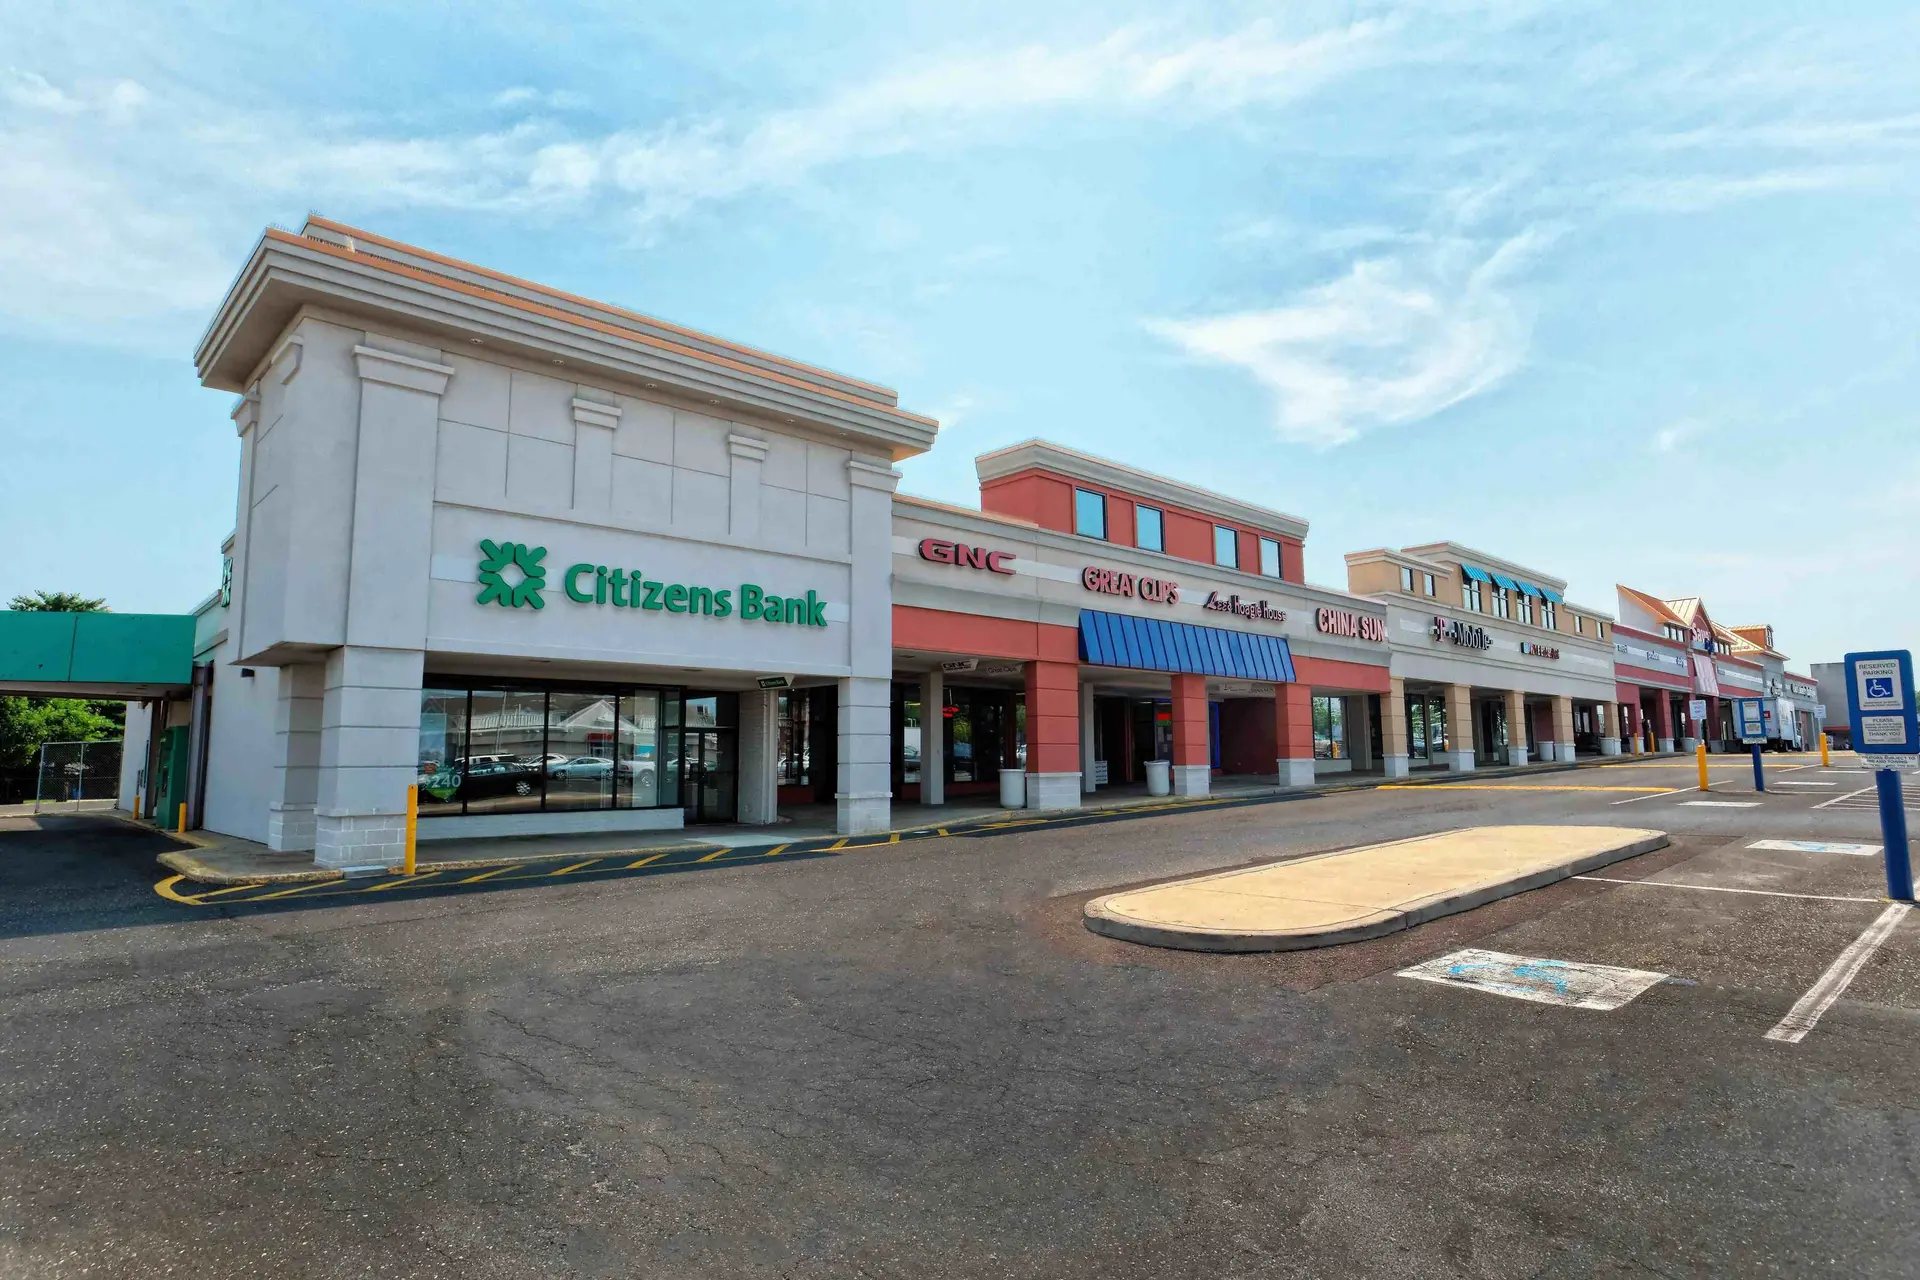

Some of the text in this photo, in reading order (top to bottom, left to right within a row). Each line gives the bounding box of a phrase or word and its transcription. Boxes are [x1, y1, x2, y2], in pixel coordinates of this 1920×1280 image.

[918, 538, 1017, 575] GNC
[564, 563, 829, 628] Citizens Bank
[1082, 565, 1181, 605] GREAT CLIPS
[1315, 607, 1386, 642] CHINA SUN
[431, 774, 462, 789] 240
